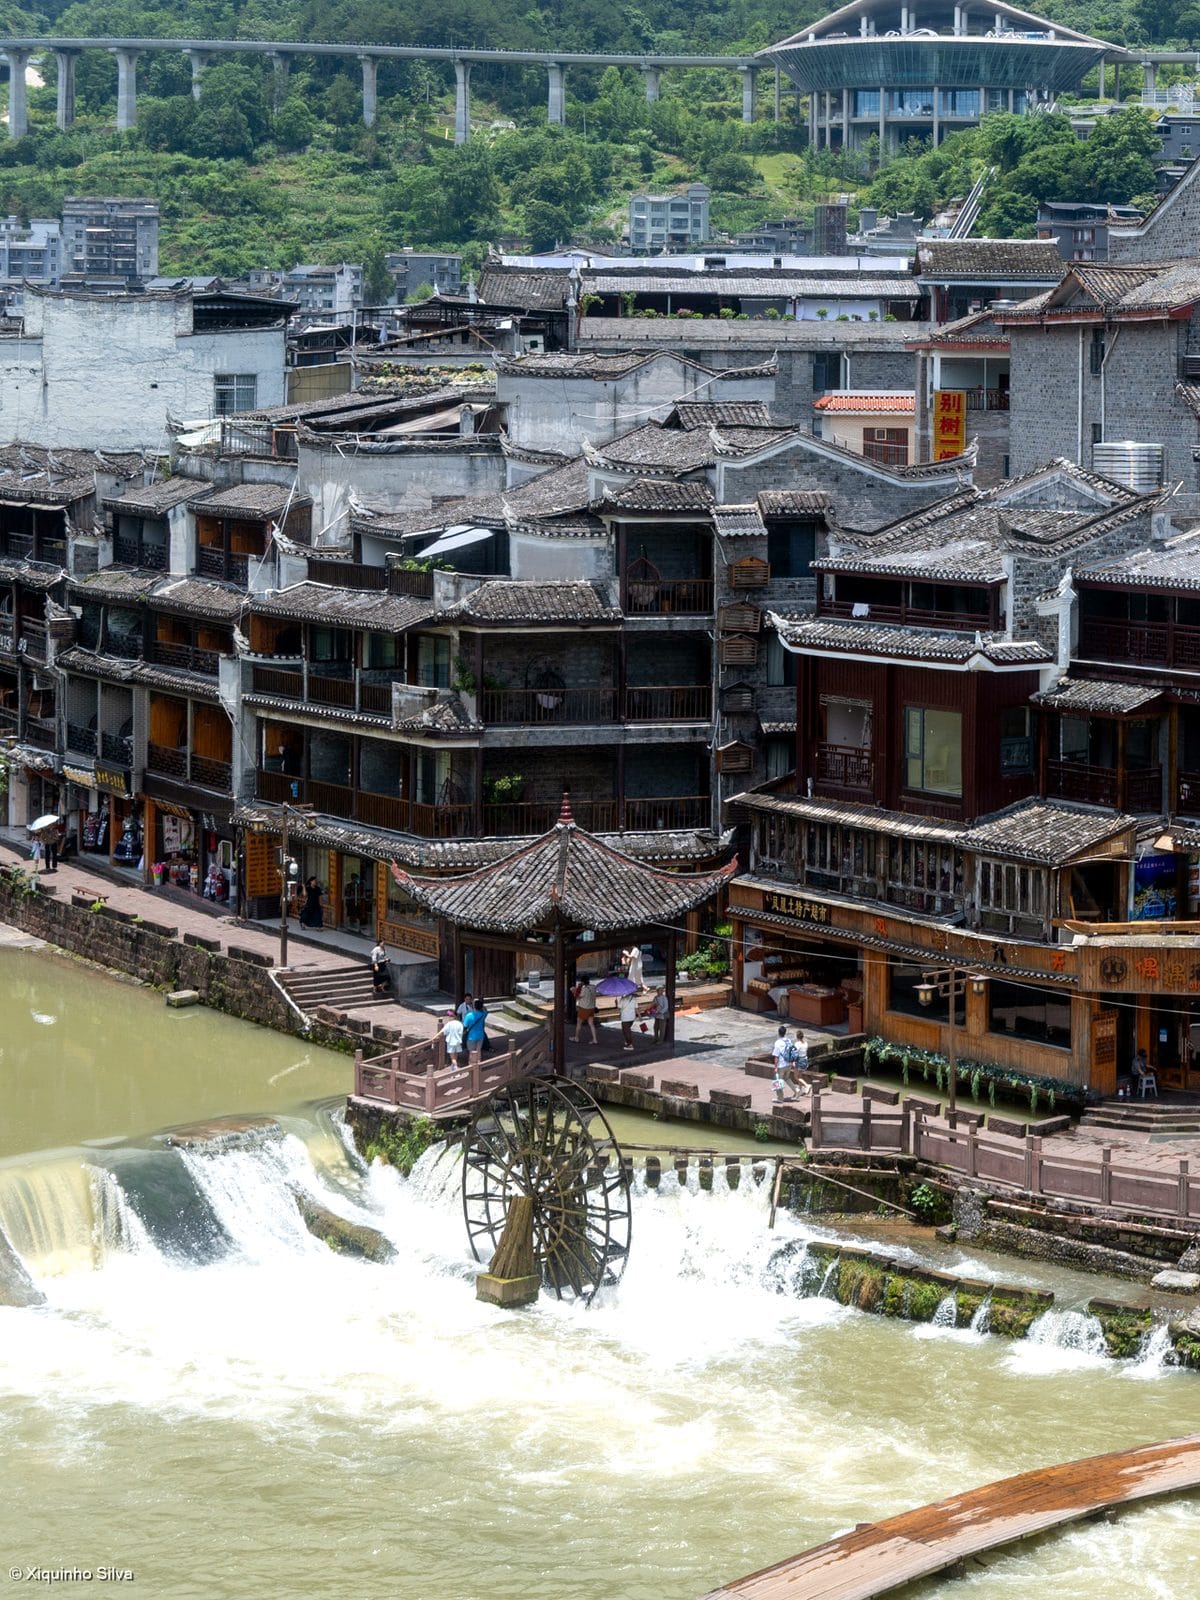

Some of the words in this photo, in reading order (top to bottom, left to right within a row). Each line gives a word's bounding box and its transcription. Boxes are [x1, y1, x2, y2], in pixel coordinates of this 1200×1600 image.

[771, 895, 827, 922] 凤凰土特产超市
